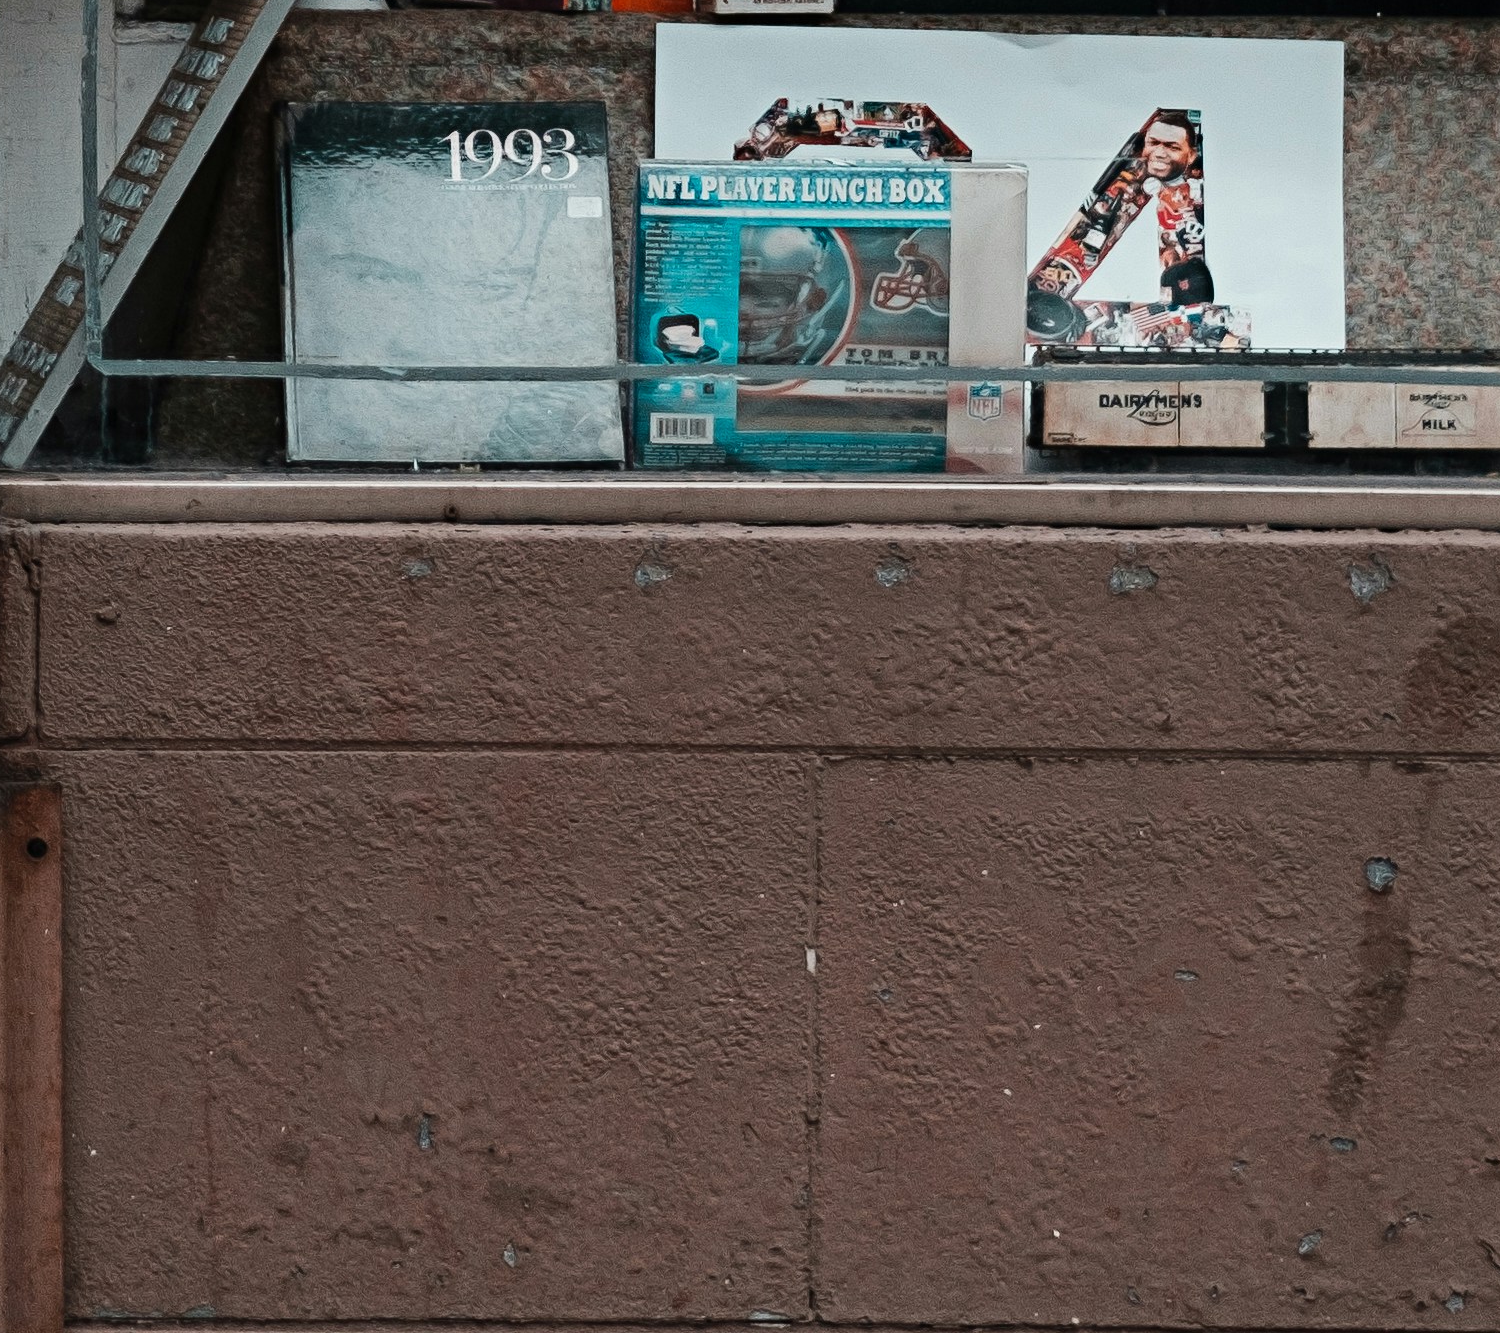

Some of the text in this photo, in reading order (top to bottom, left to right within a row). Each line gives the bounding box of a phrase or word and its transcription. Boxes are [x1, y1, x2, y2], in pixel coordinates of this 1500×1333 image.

[437, 128, 580, 183] 1993
[647, 173, 946, 205] NFL PLAYER LUNCH BOX
[845, 348, 894, 360] TOM
[1422, 418, 1458, 432] MILK
